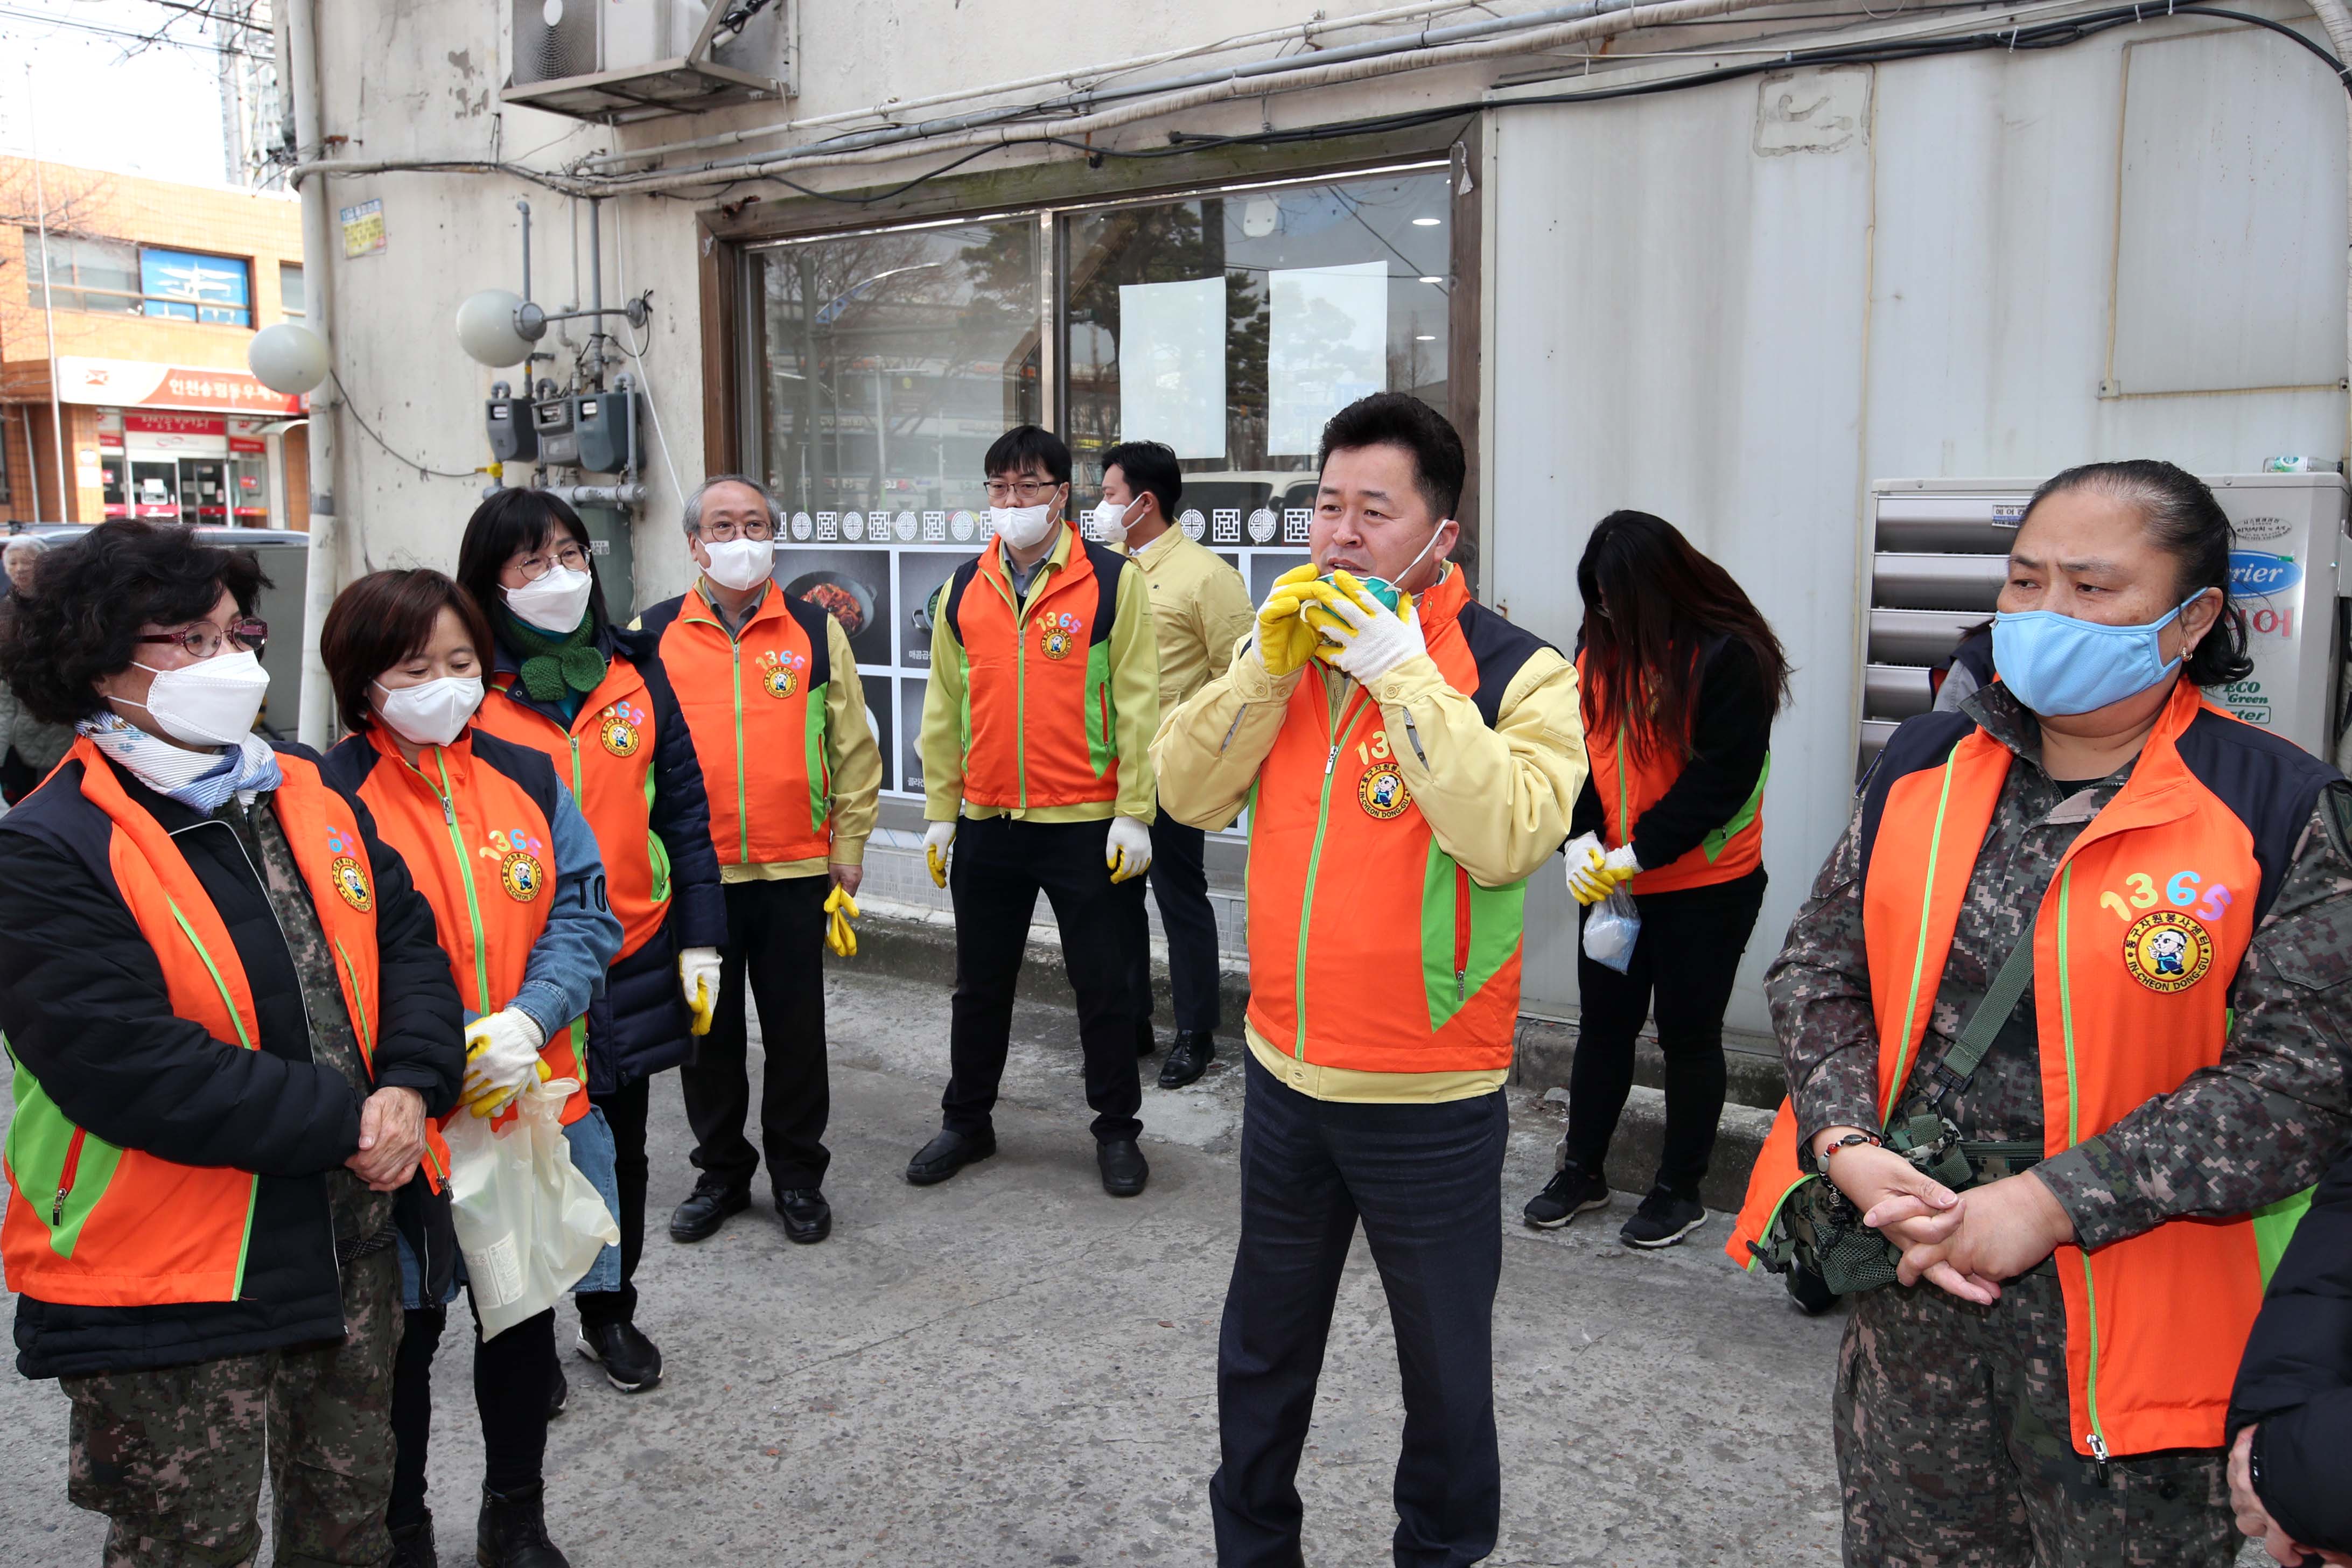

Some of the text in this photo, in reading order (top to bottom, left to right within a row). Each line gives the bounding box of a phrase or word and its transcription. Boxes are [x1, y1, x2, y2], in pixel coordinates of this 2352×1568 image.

[2228, 563, 2284, 583] rier
[1035, 611, 1082, 634] 1365
[755, 650, 806, 670] 1365
[908, 650, 932, 660] 매콤곱
[2223, 681, 2261, 694] ECO
[2228, 694, 2269, 704] Green
[1354, 730, 1390, 766] 13
[1362, 763, 1401, 783] 동구자원봉
[1359, 791, 1409, 818] IN-CHEON DONG-GU
[479, 829, 542, 860] 1365
[2100, 870, 2232, 921] 1365
[2125, 913, 2210, 948] 동구자원봉사센터
[2128, 957, 2210, 991] IN-CHEON DONG-GU
